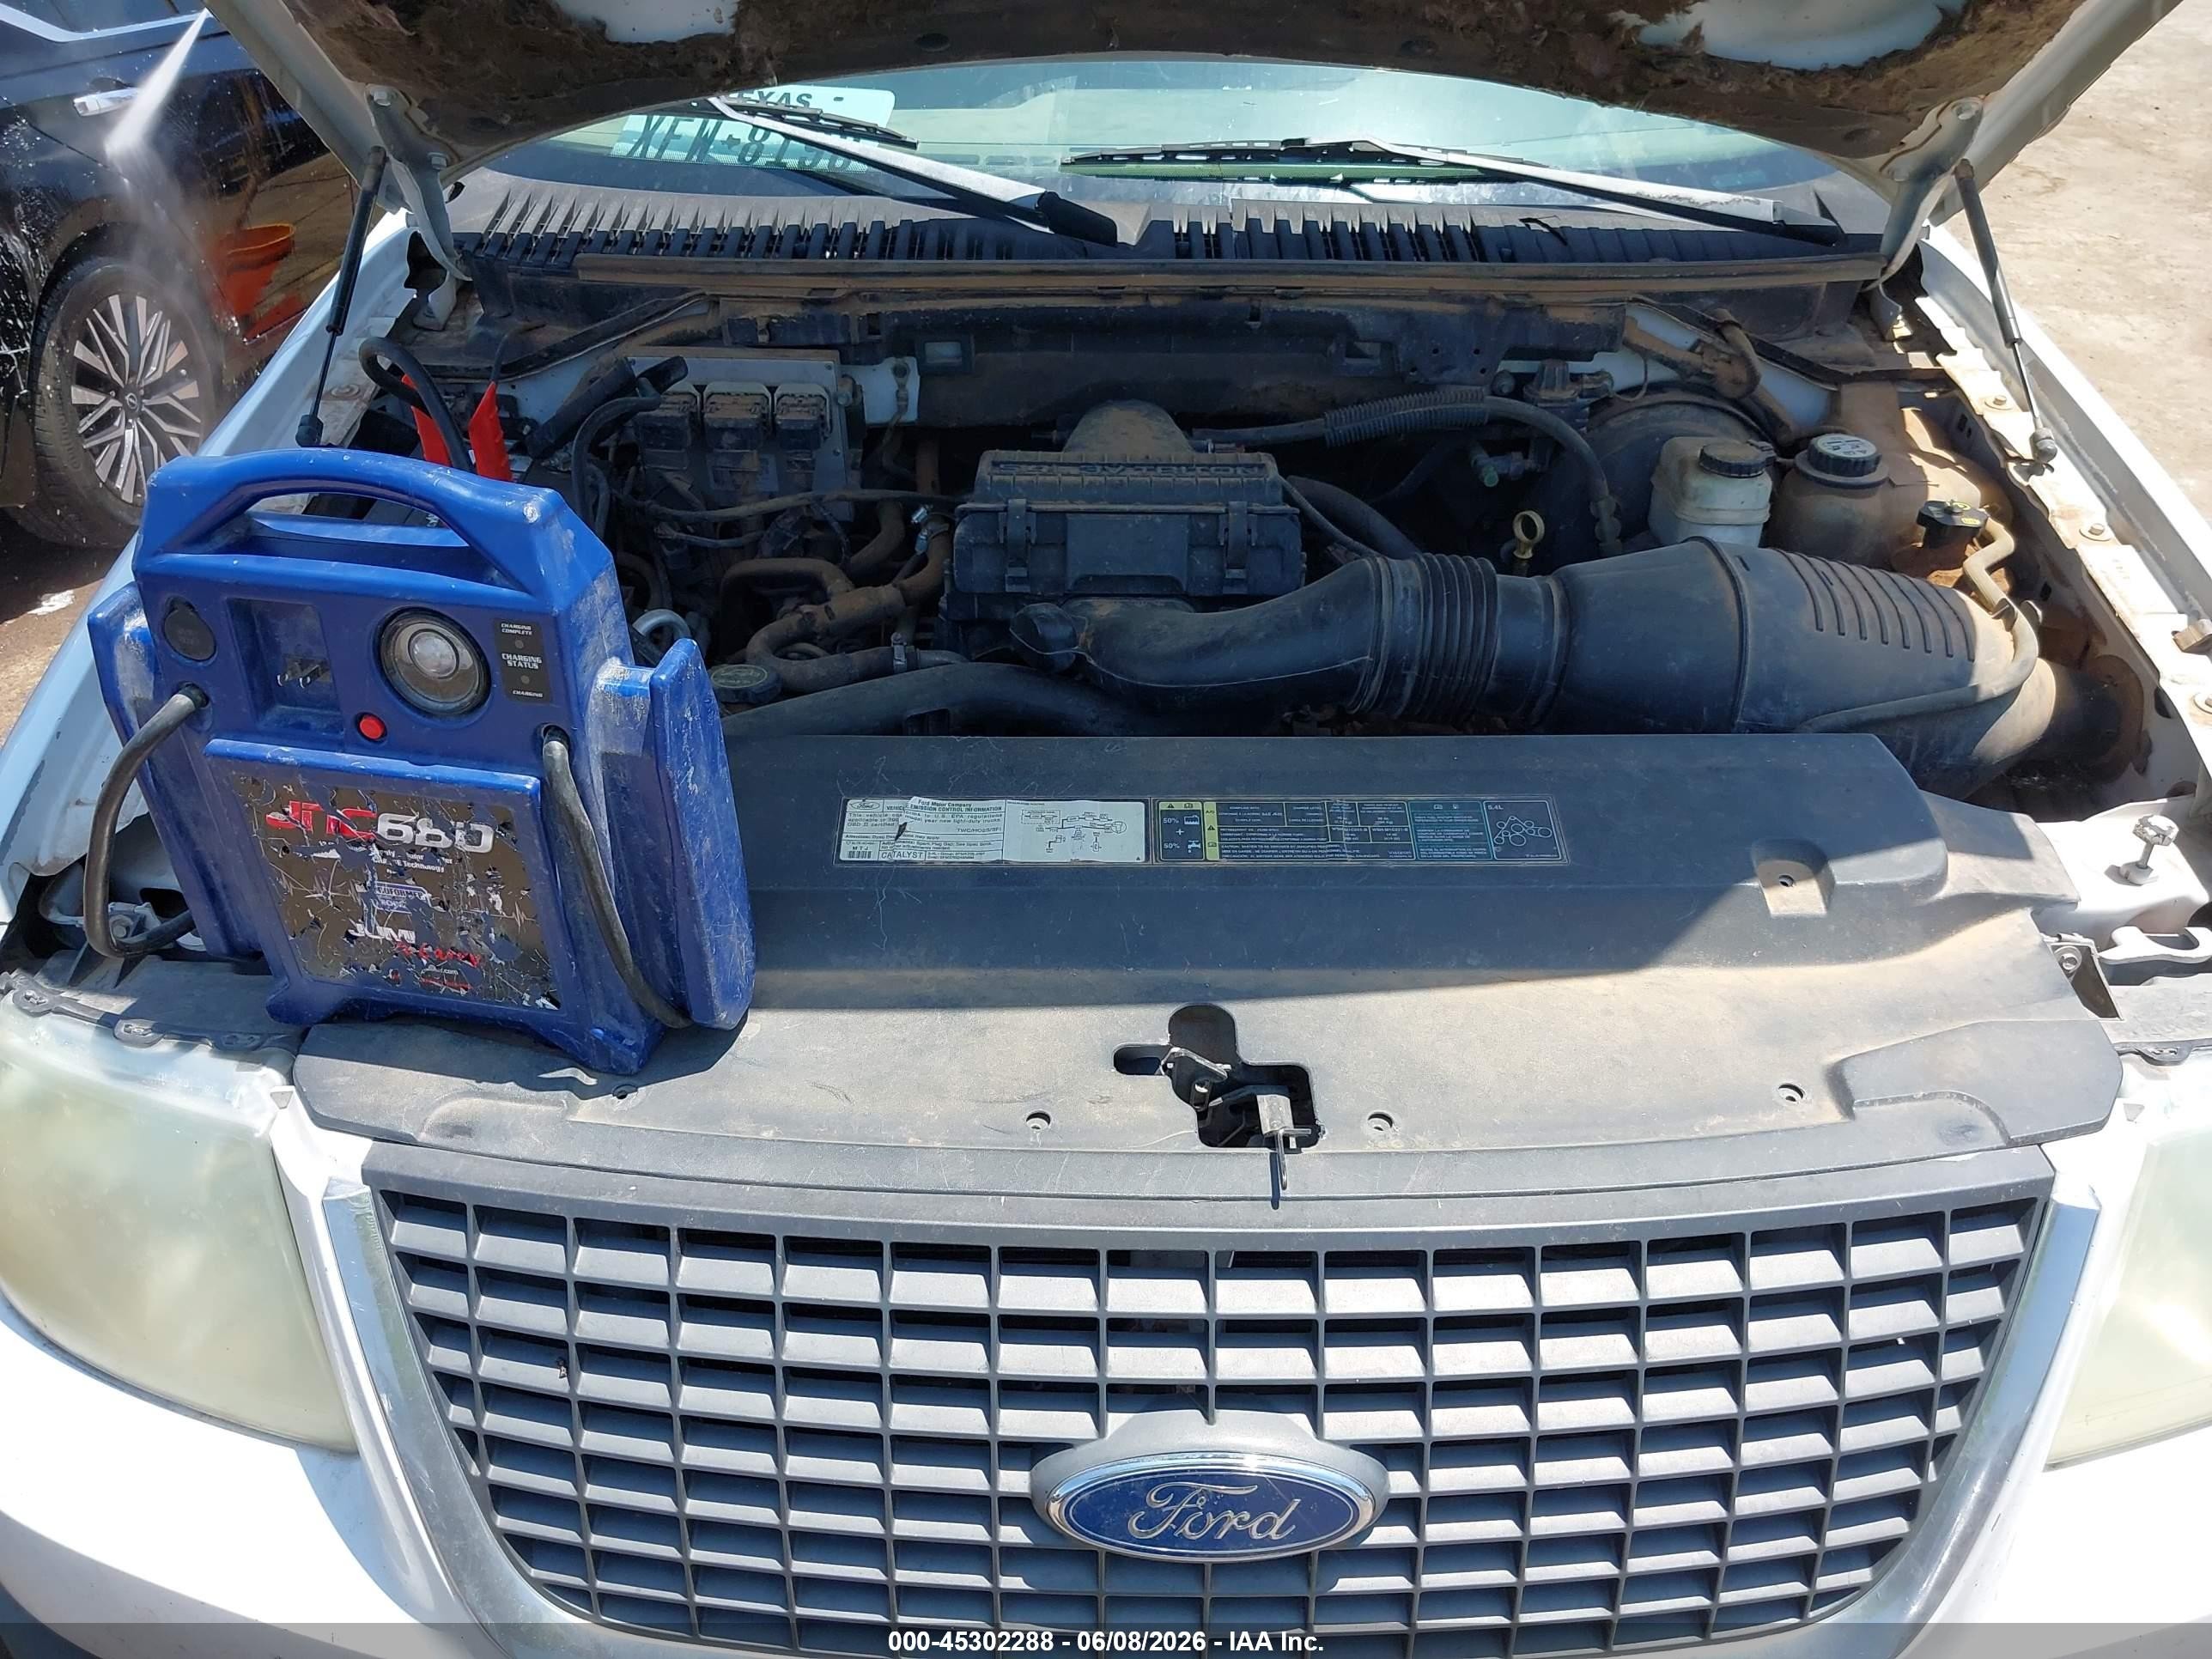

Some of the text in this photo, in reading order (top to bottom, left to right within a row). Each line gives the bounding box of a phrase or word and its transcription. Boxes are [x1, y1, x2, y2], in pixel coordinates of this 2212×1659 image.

[501, 623, 532, 631] CHARGING
[501, 653, 543, 664] CHARGING
[507, 660, 539, 670] STATUS
[512, 690, 544, 698] CHARGING
[910, 804, 937, 812] EMISSION
[1127, 1481, 1302, 1541] Ford
